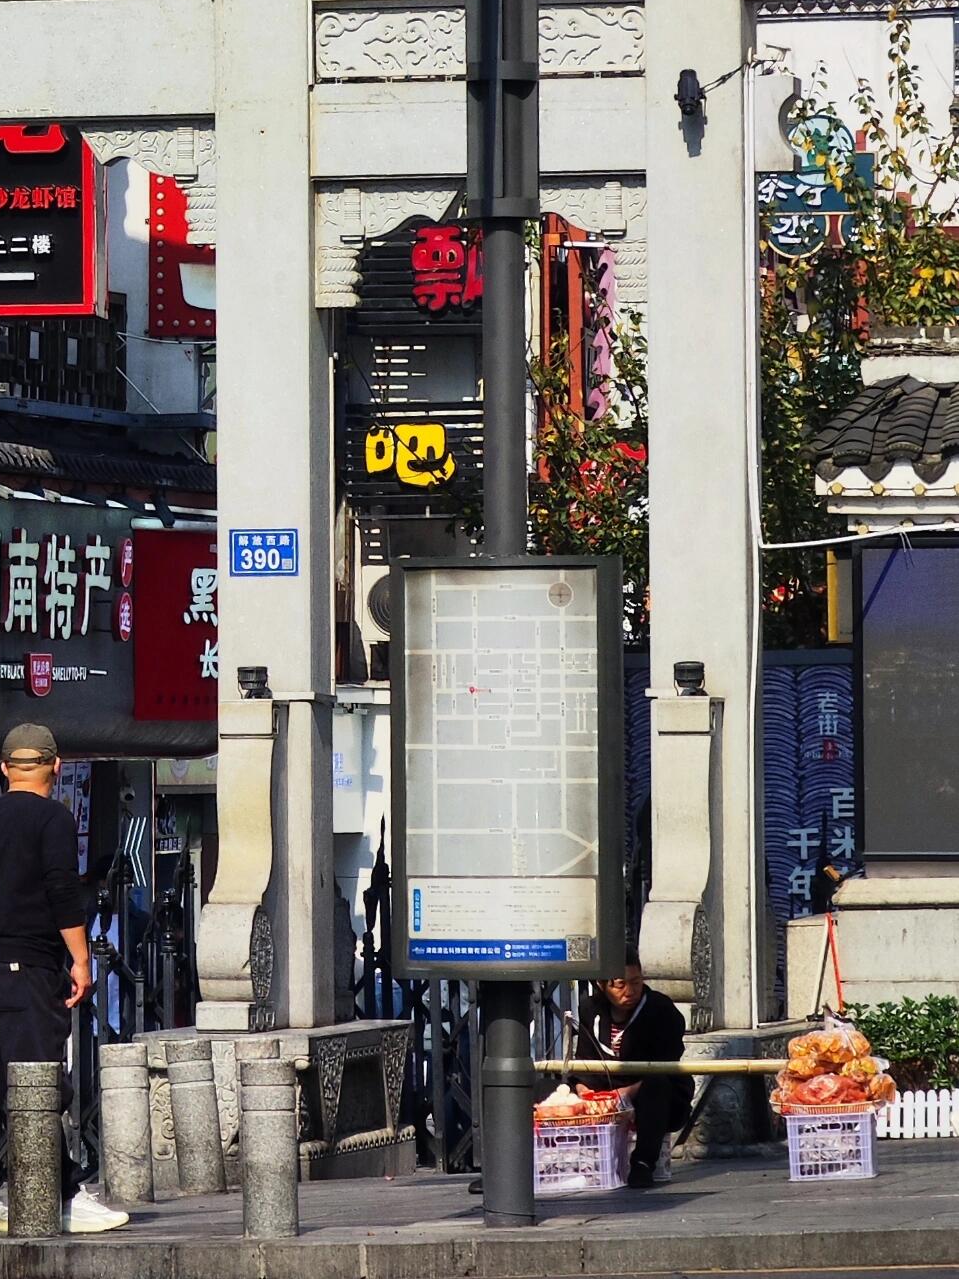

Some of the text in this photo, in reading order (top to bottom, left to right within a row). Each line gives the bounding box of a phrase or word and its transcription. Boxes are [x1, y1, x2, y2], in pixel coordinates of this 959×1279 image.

[240, 548, 281, 570] 390
[818, 690, 838, 735] 老街
[829, 787, 855, 875] 百米
[786, 828, 821, 917] 千年
